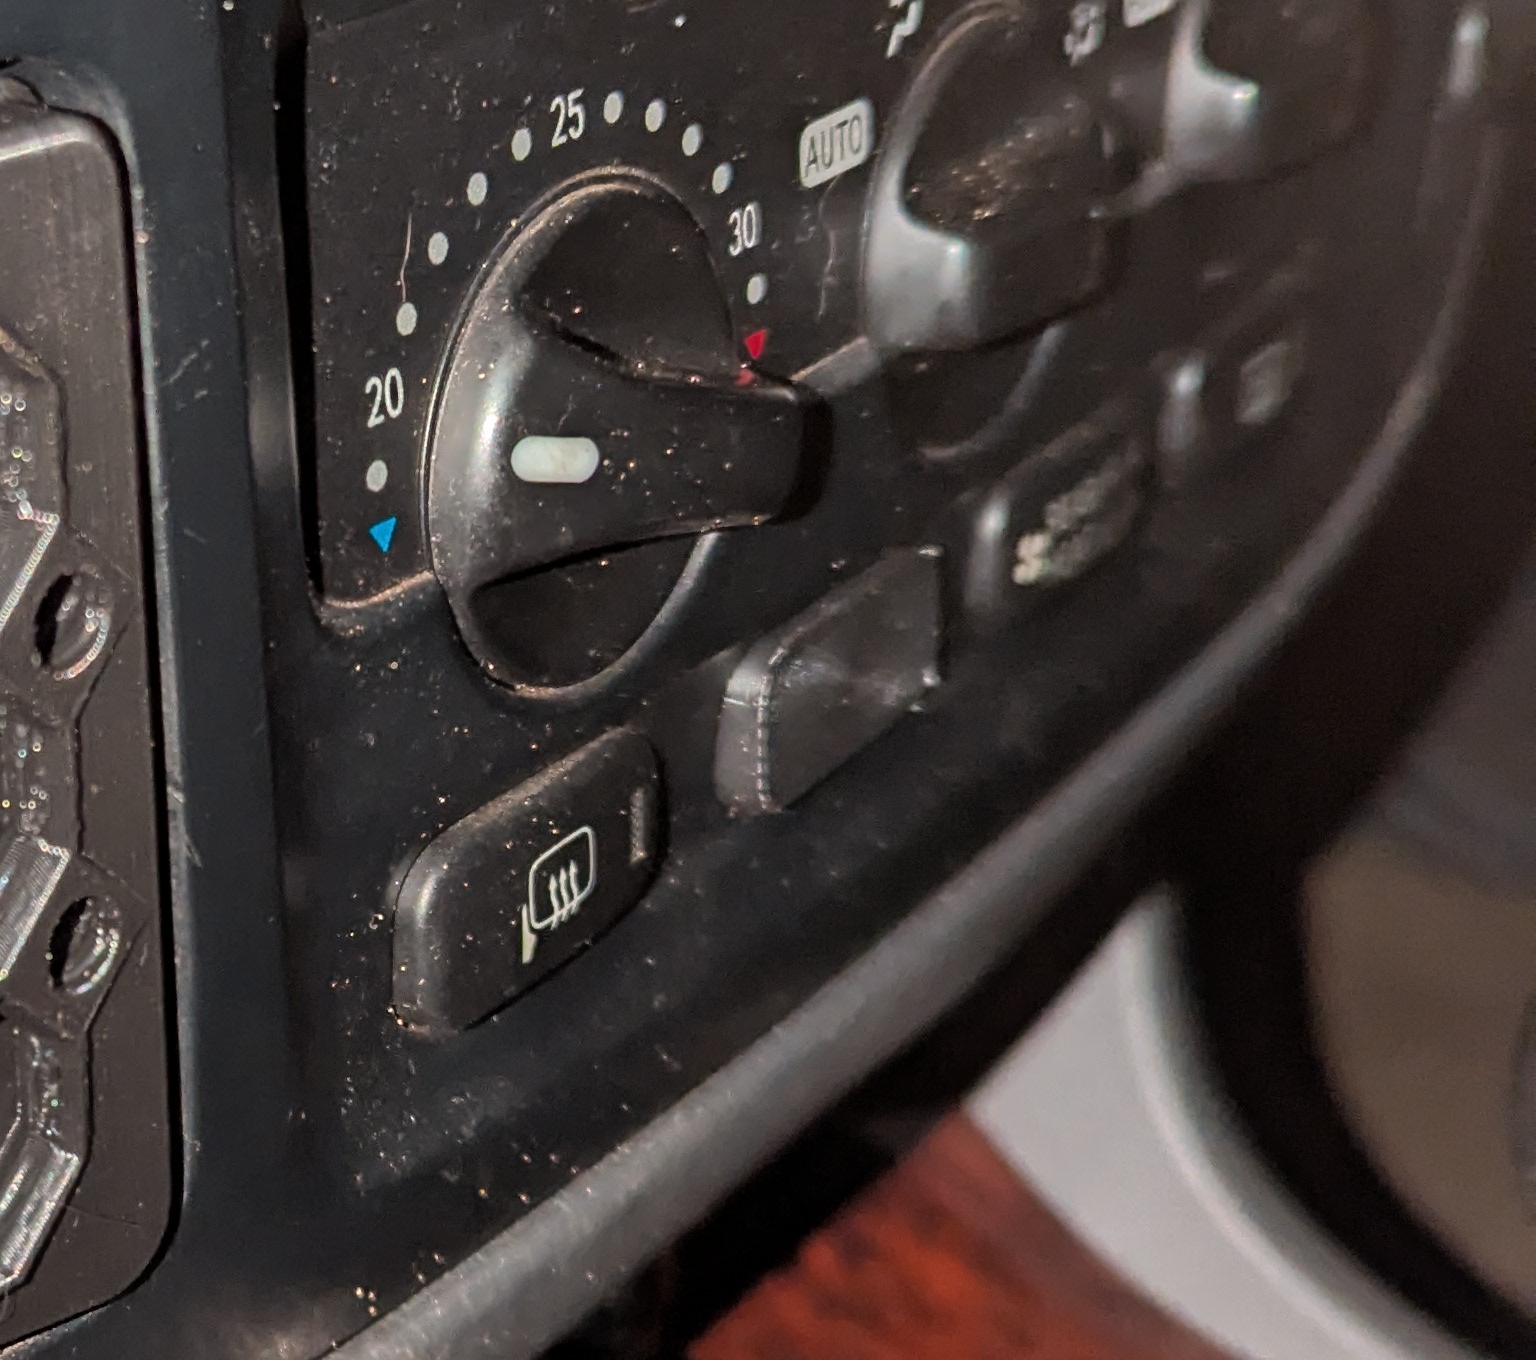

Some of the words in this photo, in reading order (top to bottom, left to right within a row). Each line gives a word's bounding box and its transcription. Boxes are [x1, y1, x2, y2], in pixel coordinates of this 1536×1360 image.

[551, 88, 585, 147] 25
[804, 113, 864, 175] AUTO
[728, 202, 760, 255] 30
[366, 367, 404, 428] 20
